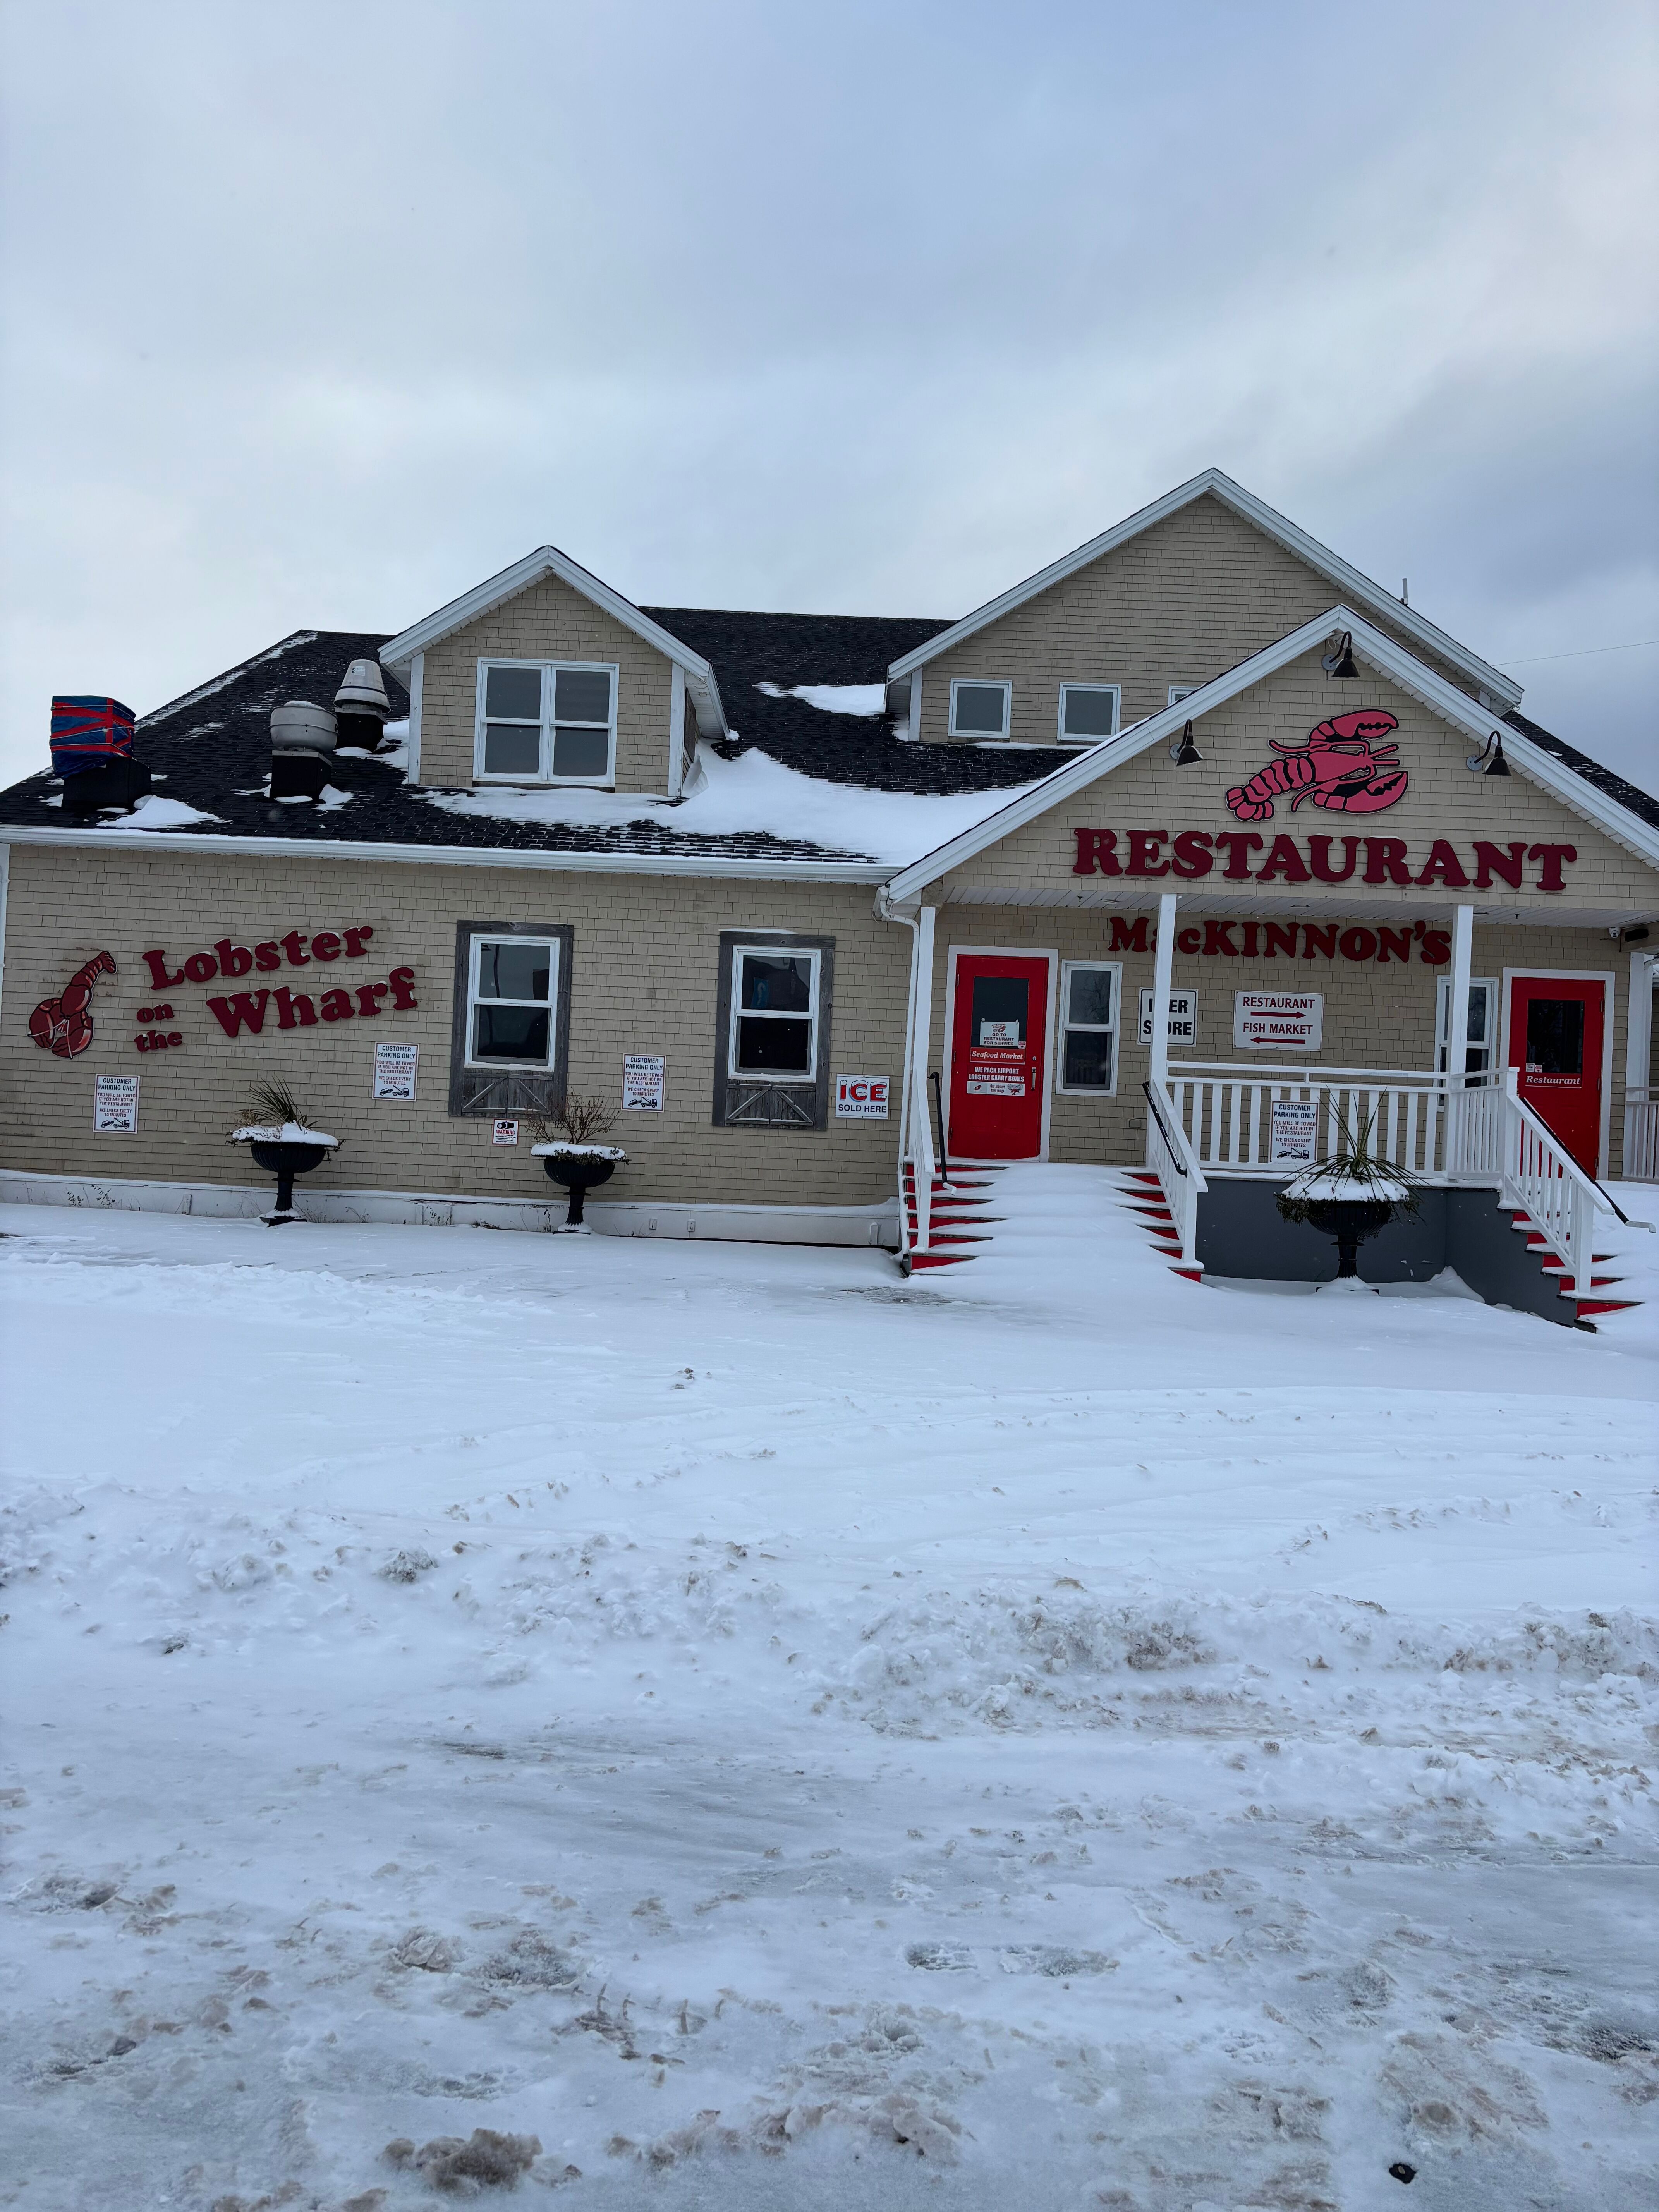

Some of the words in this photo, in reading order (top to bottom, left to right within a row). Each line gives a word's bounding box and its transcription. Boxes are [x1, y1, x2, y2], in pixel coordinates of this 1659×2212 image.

[1073, 828, 1578, 890] RESTAURANT
[142, 925, 373, 991] Lobster
[136, 1004, 175, 1023] on
[206, 967, 418, 1038] Wharf
[1243, 997, 1315, 1008] RESTAURANT
[1243, 1022, 1265, 1033] FISH
[1270, 1024, 1313, 1034] MARKET
[134, 1030, 182, 1052] the
[840, 1080, 887, 1102] ICE
[1526, 1076, 1581, 1084] Restaurant
